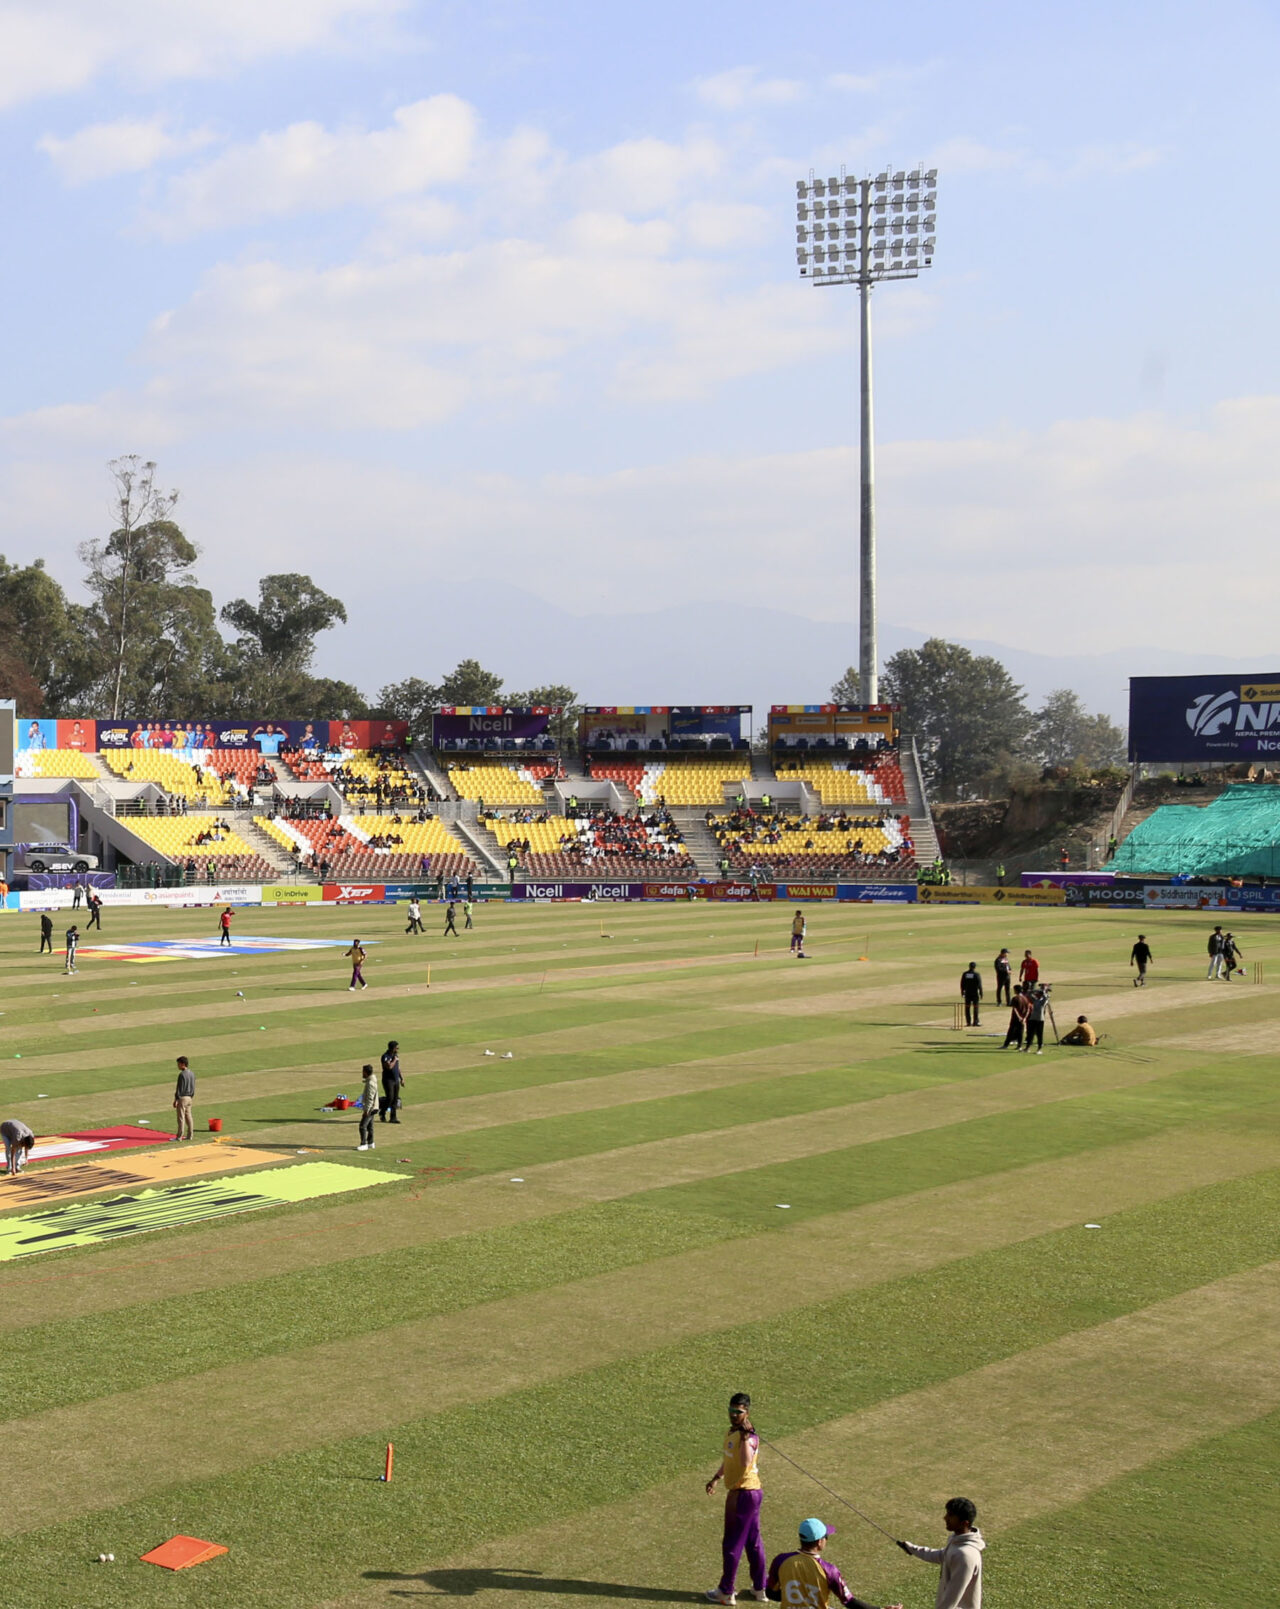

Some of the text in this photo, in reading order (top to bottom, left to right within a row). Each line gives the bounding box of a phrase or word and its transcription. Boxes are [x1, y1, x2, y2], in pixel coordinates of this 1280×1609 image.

[469, 717, 513, 732] Ncell
[110, 733, 129, 742] NPL
[230, 733, 248, 742] NPL
[284, 890, 309, 898] inDrive
[525, 884, 563, 898] Ncell
[592, 884, 629, 897] Ncell
[788, 886, 834, 896] WAI WAI
[1088, 889, 1144, 900] MOODS
[1159, 888, 1198, 900] Siddhartha
[1242, 891, 1265, 900] SPIL
